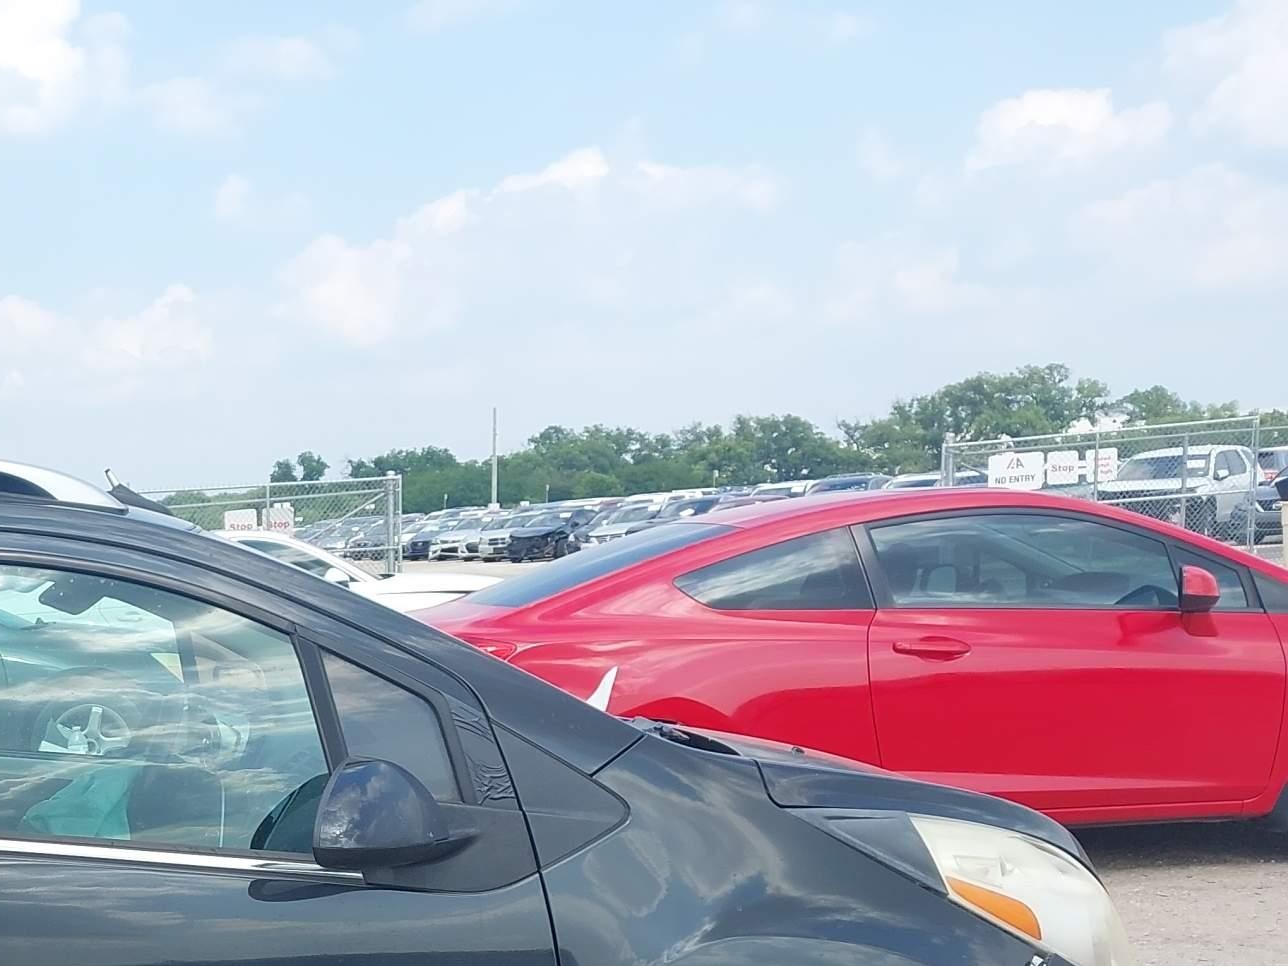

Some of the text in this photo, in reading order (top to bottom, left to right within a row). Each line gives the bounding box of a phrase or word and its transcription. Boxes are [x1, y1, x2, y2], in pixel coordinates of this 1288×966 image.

[1051, 464, 1075, 473] Stop
[994, 474, 1036, 485] NO ENTRY
